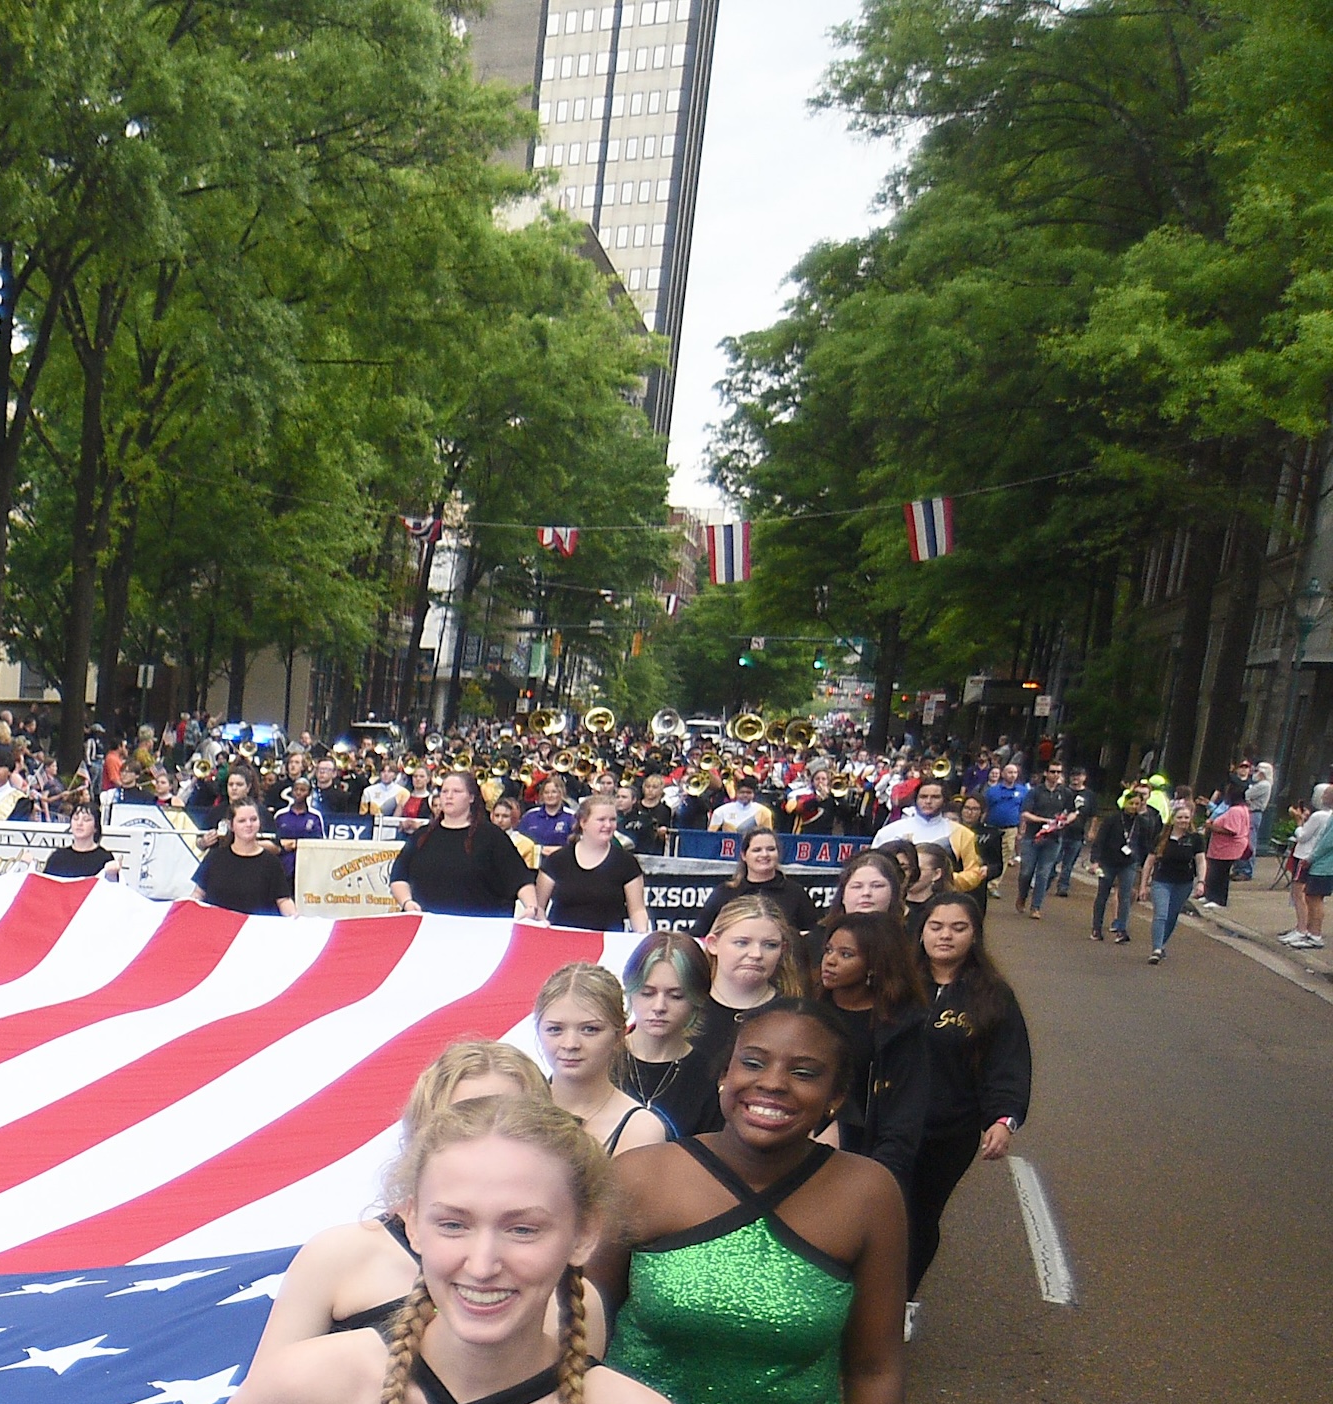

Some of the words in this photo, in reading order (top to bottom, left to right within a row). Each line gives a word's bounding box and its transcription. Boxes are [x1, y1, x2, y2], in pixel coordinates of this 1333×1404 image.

[329, 824, 366, 840] ISY
[795, 842, 870, 861] BAN
[643, 886, 714, 908] IXSON
